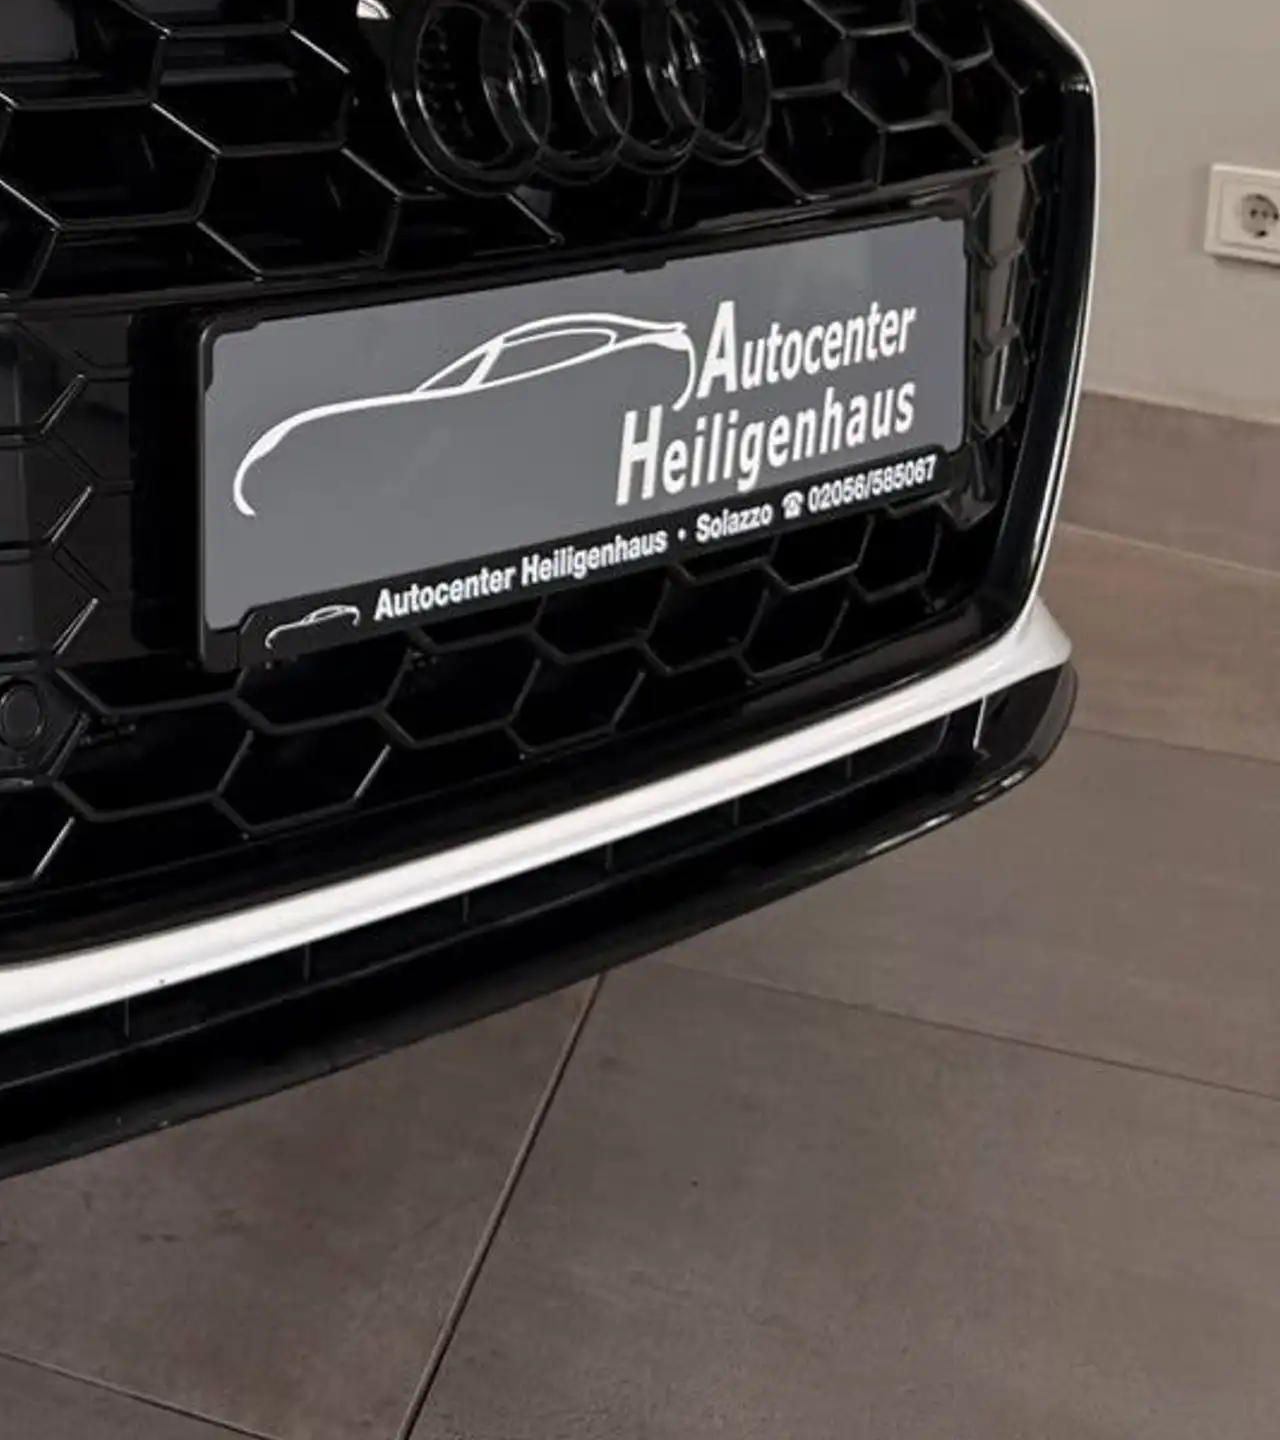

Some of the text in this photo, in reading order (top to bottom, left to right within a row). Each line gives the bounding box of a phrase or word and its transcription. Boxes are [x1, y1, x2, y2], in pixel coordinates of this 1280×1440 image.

[696, 300, 917, 399] Autocenter
[615, 381, 917, 506] Heiligenhaus
[373, 454, 938, 621] Autocenter Heiligenhaus Solazzo 02056/585067
